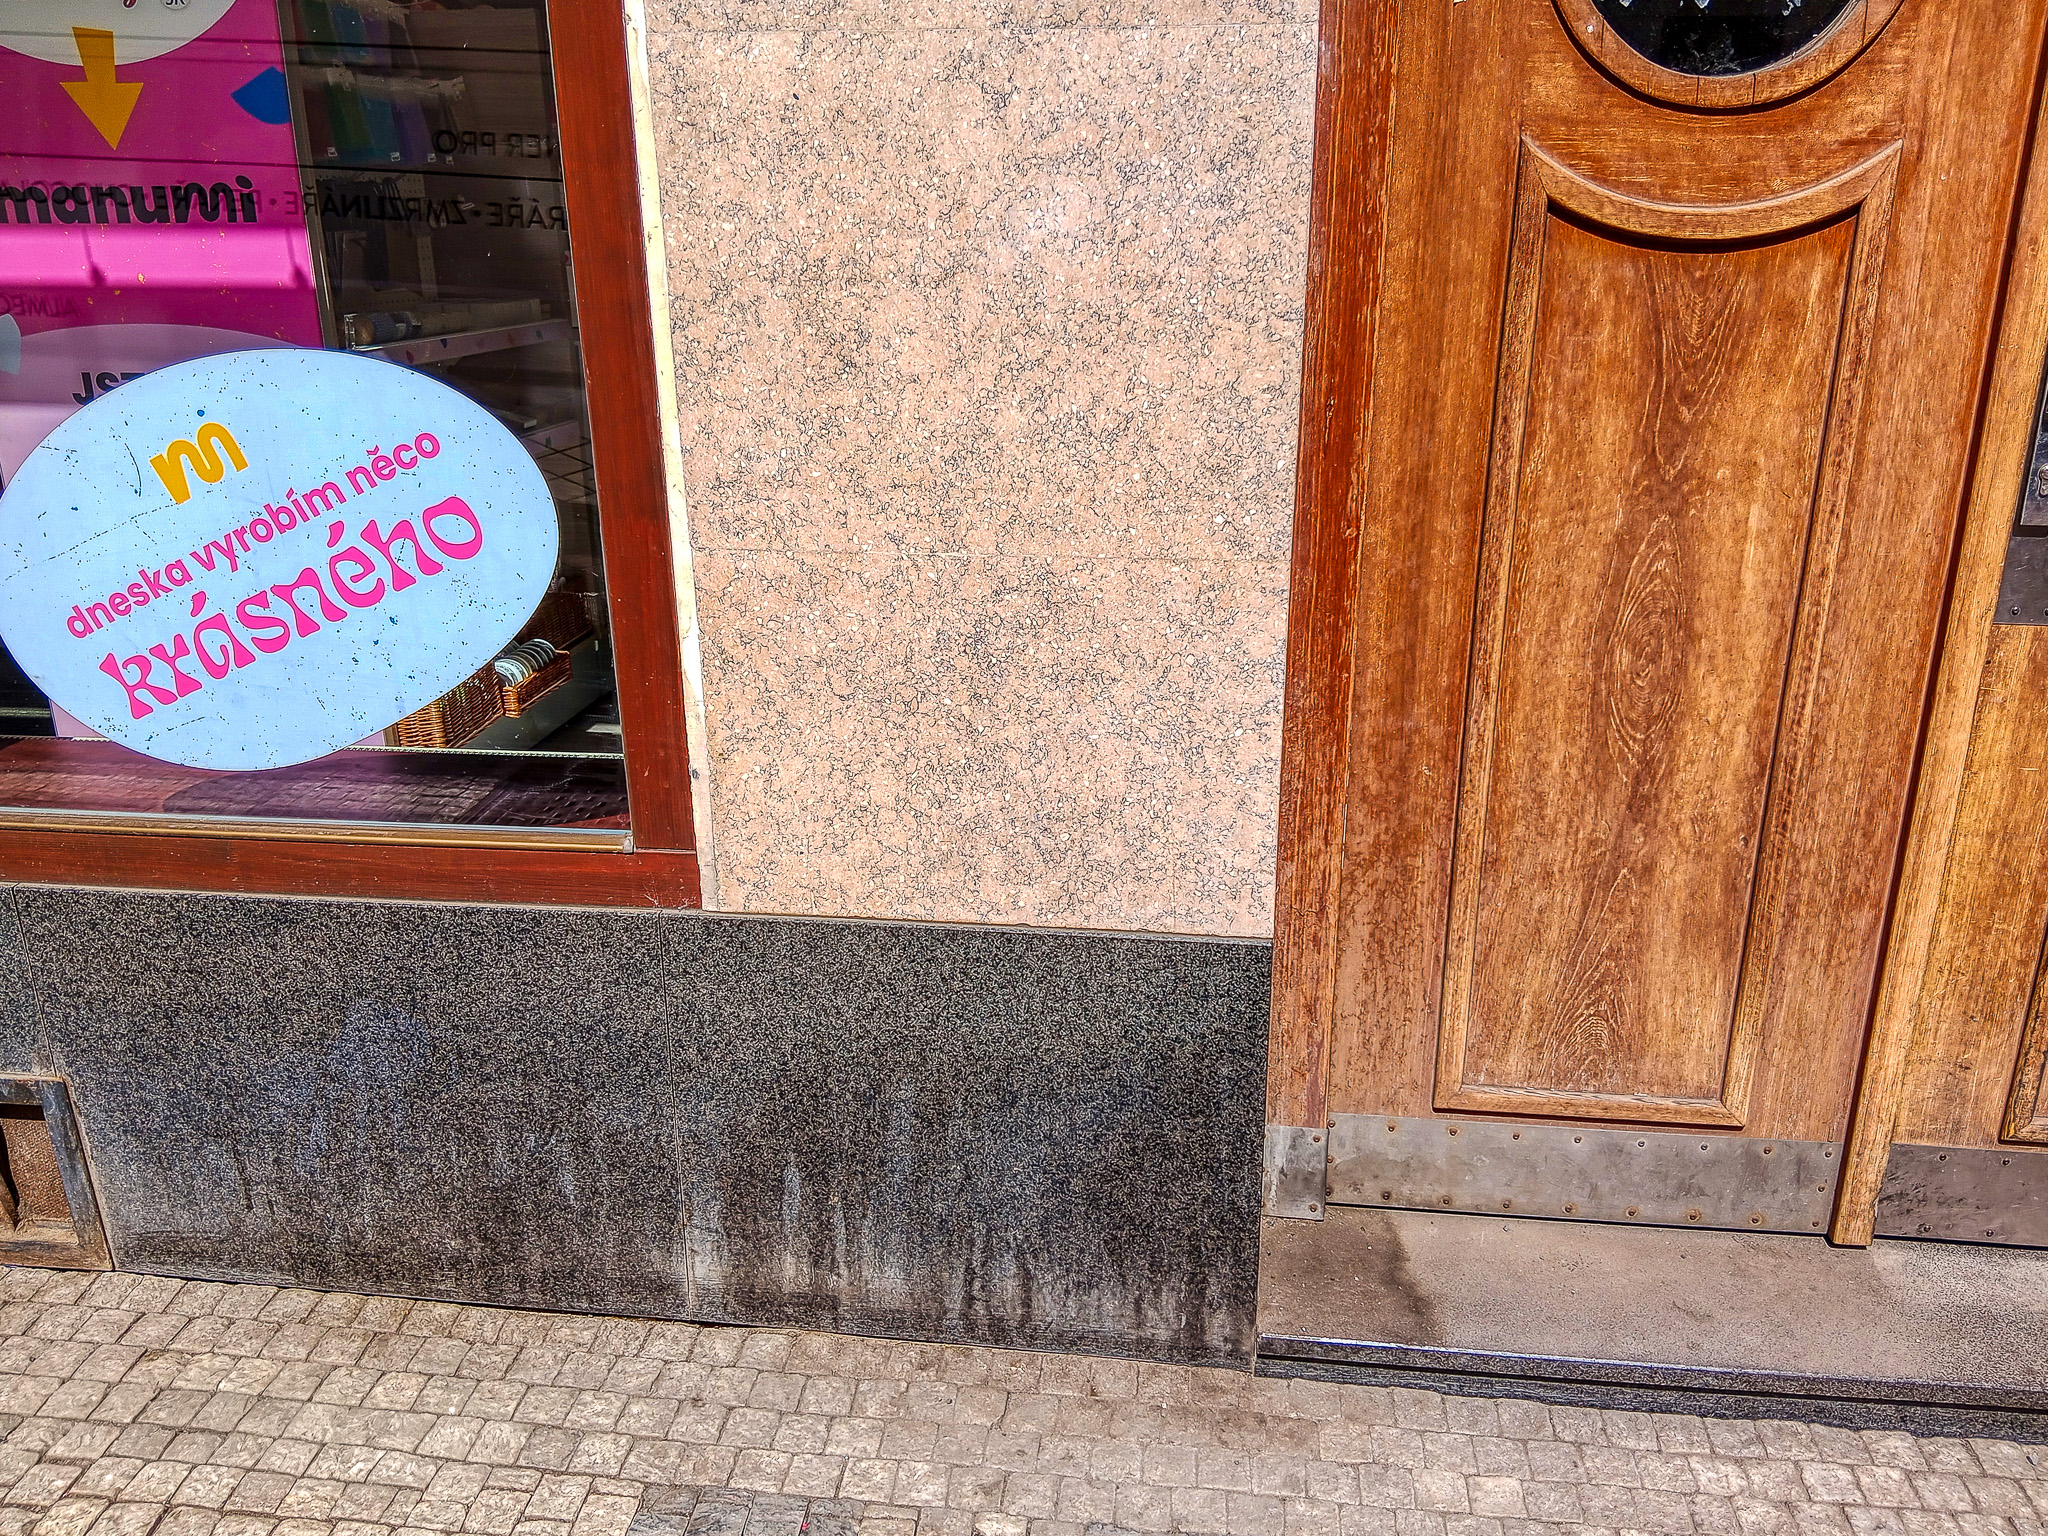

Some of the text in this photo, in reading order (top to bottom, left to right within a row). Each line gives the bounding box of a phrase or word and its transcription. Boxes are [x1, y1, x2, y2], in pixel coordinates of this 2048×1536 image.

[66, 432, 441, 639] dneska vyrobím něco
[98, 495, 484, 720] krásného
